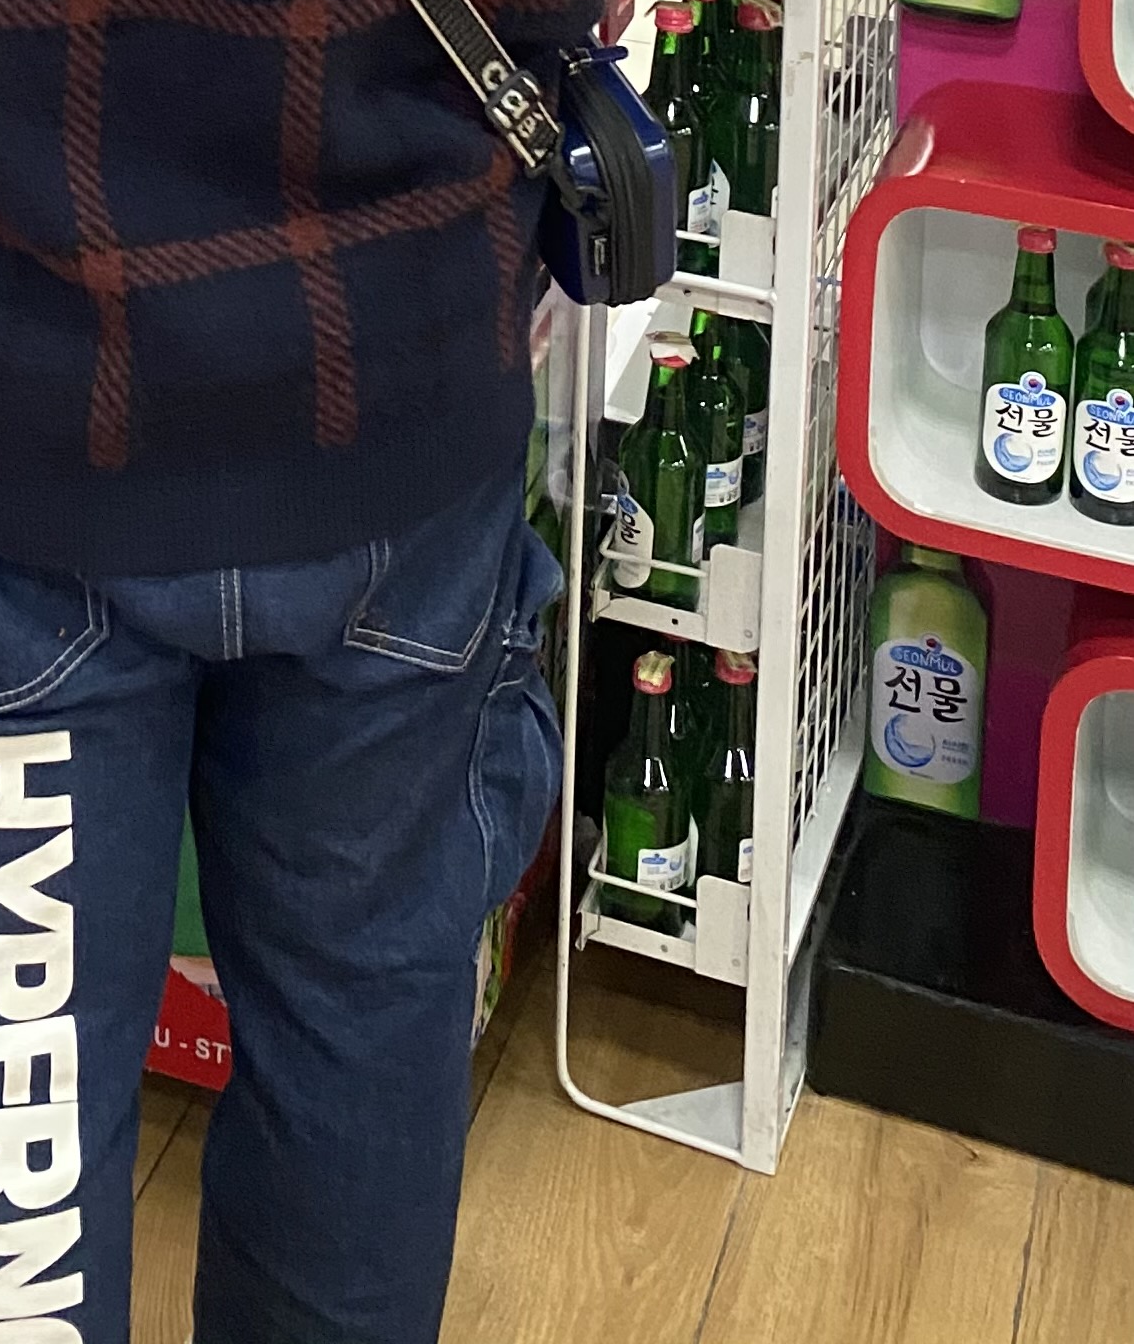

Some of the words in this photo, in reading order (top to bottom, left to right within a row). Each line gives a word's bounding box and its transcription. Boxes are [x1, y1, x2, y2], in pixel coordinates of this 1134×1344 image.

[995, 401, 1058, 437] 선물
[895, 648, 959, 675] SEONMUL
[884, 665, 968, 723] 선물
